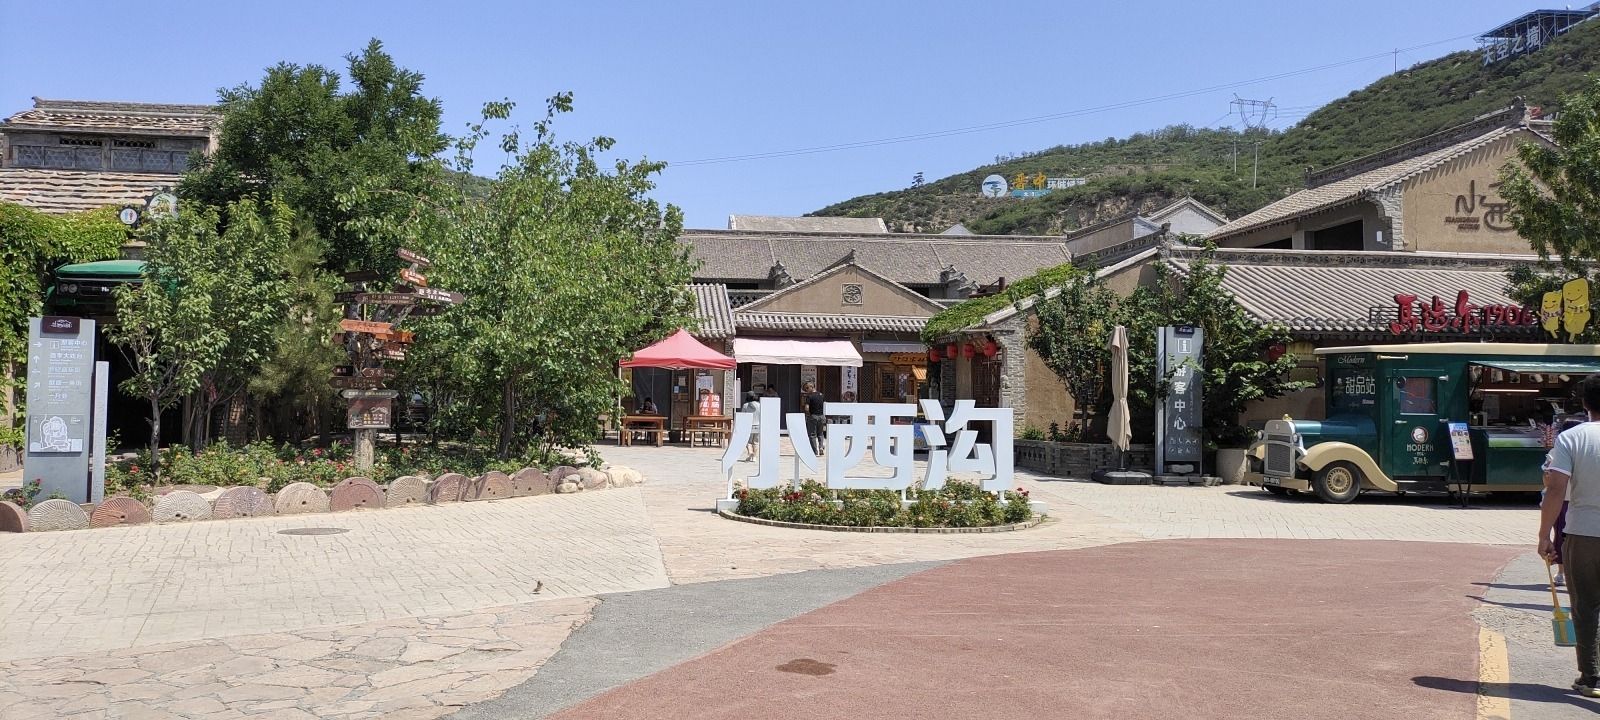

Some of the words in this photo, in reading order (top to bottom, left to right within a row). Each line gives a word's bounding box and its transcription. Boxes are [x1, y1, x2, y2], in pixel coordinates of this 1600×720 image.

[1483, 26, 1540, 66] 天空之境
[1454, 172, 1516, 233] 小西
[1337, 354, 1365, 364] Modern
[1173, 363, 1187, 431] 游客中心
[1345, 375, 1376, 395] 甜品站
[721, 396, 1014, 491] 小西沟
